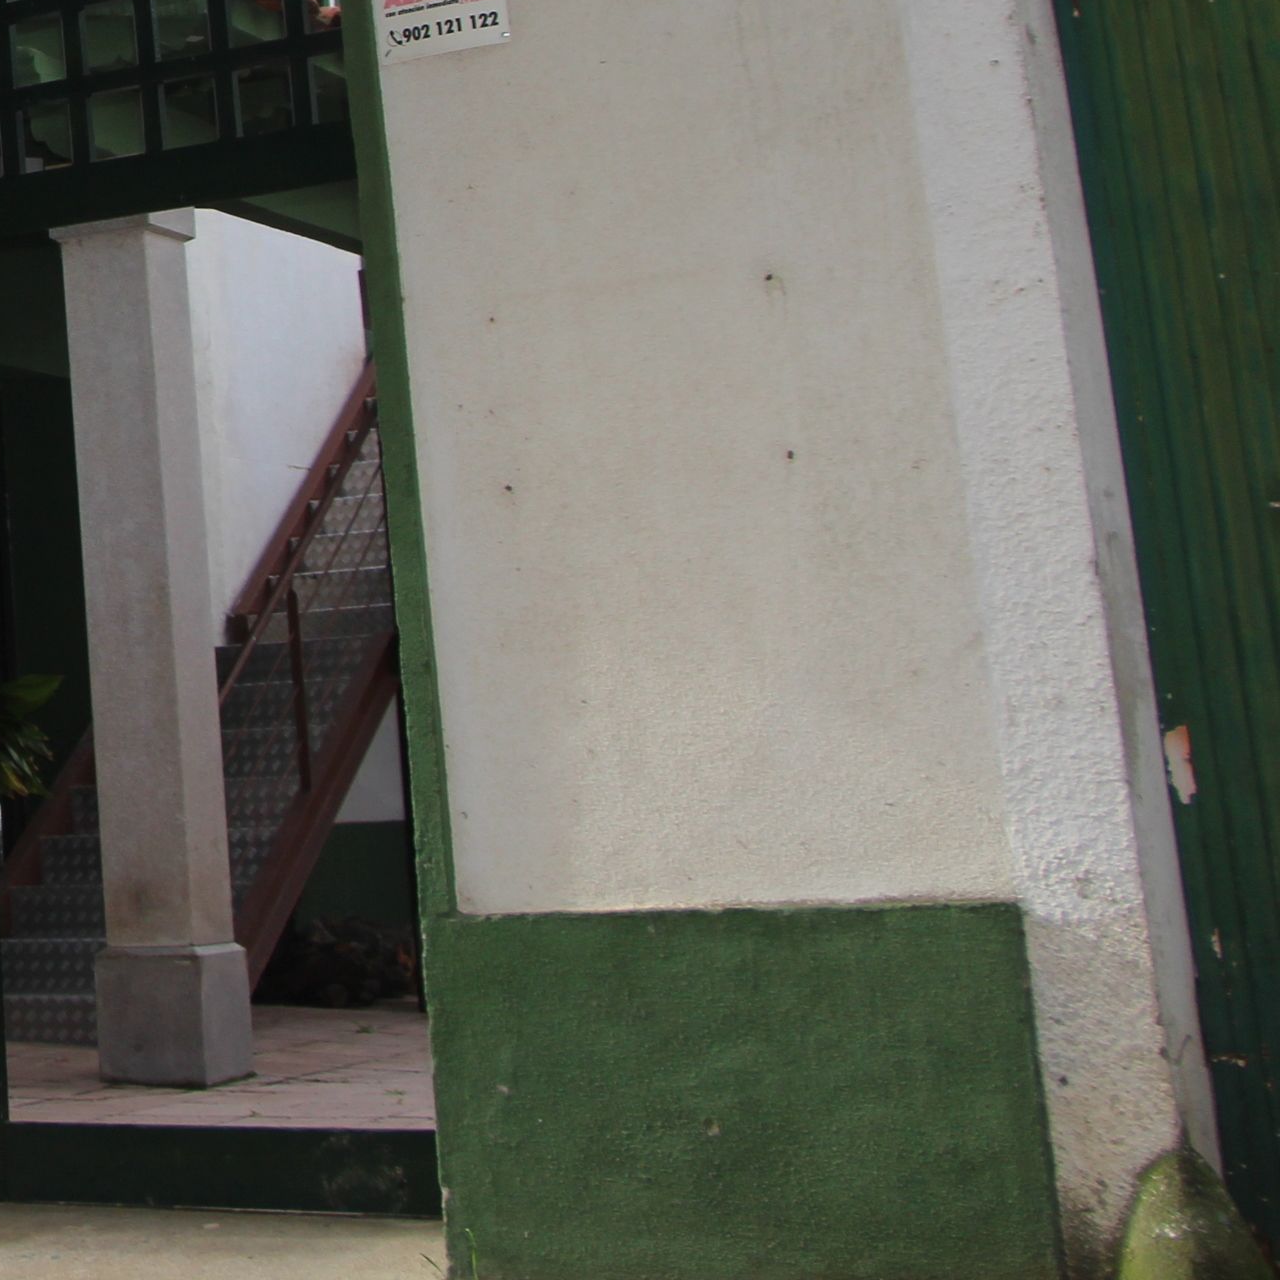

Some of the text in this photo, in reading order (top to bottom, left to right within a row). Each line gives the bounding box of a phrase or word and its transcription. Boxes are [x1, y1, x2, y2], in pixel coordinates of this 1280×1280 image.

[402, 11, 499, 43] 902 121 122
